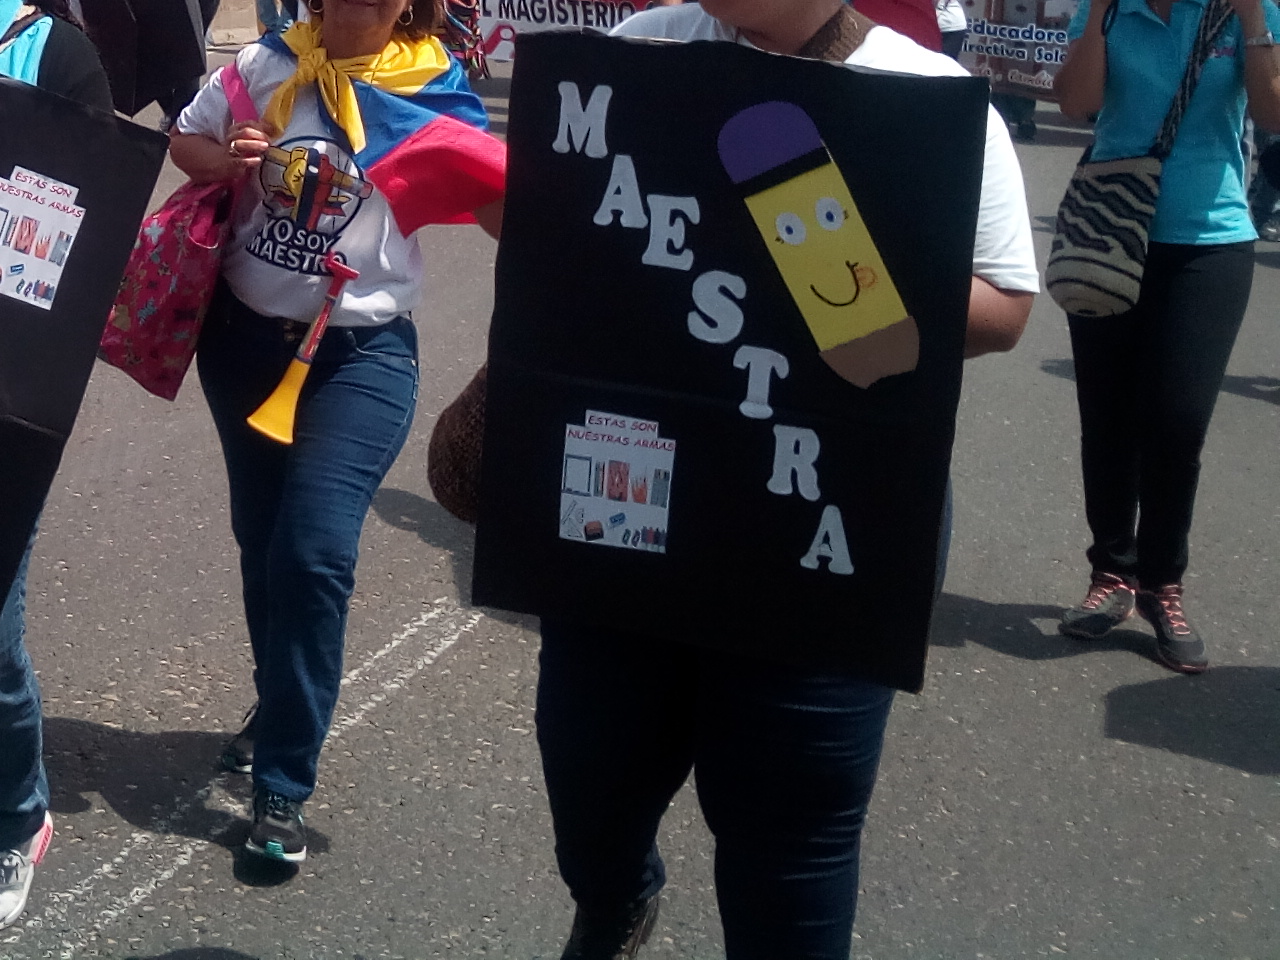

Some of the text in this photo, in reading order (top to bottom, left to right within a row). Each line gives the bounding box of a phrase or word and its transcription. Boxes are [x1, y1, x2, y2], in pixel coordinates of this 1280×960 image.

[15, 171, 73, 198] ESTAS SON
[47, 201, 83, 218] ARMAS
[261, 218, 335, 254] YO SOY
[551, 81, 855, 576] MAESTRA
[588, 415, 657, 433] ESTAS SON
[567, 428, 675, 452] NUESTRAS ARMAS
